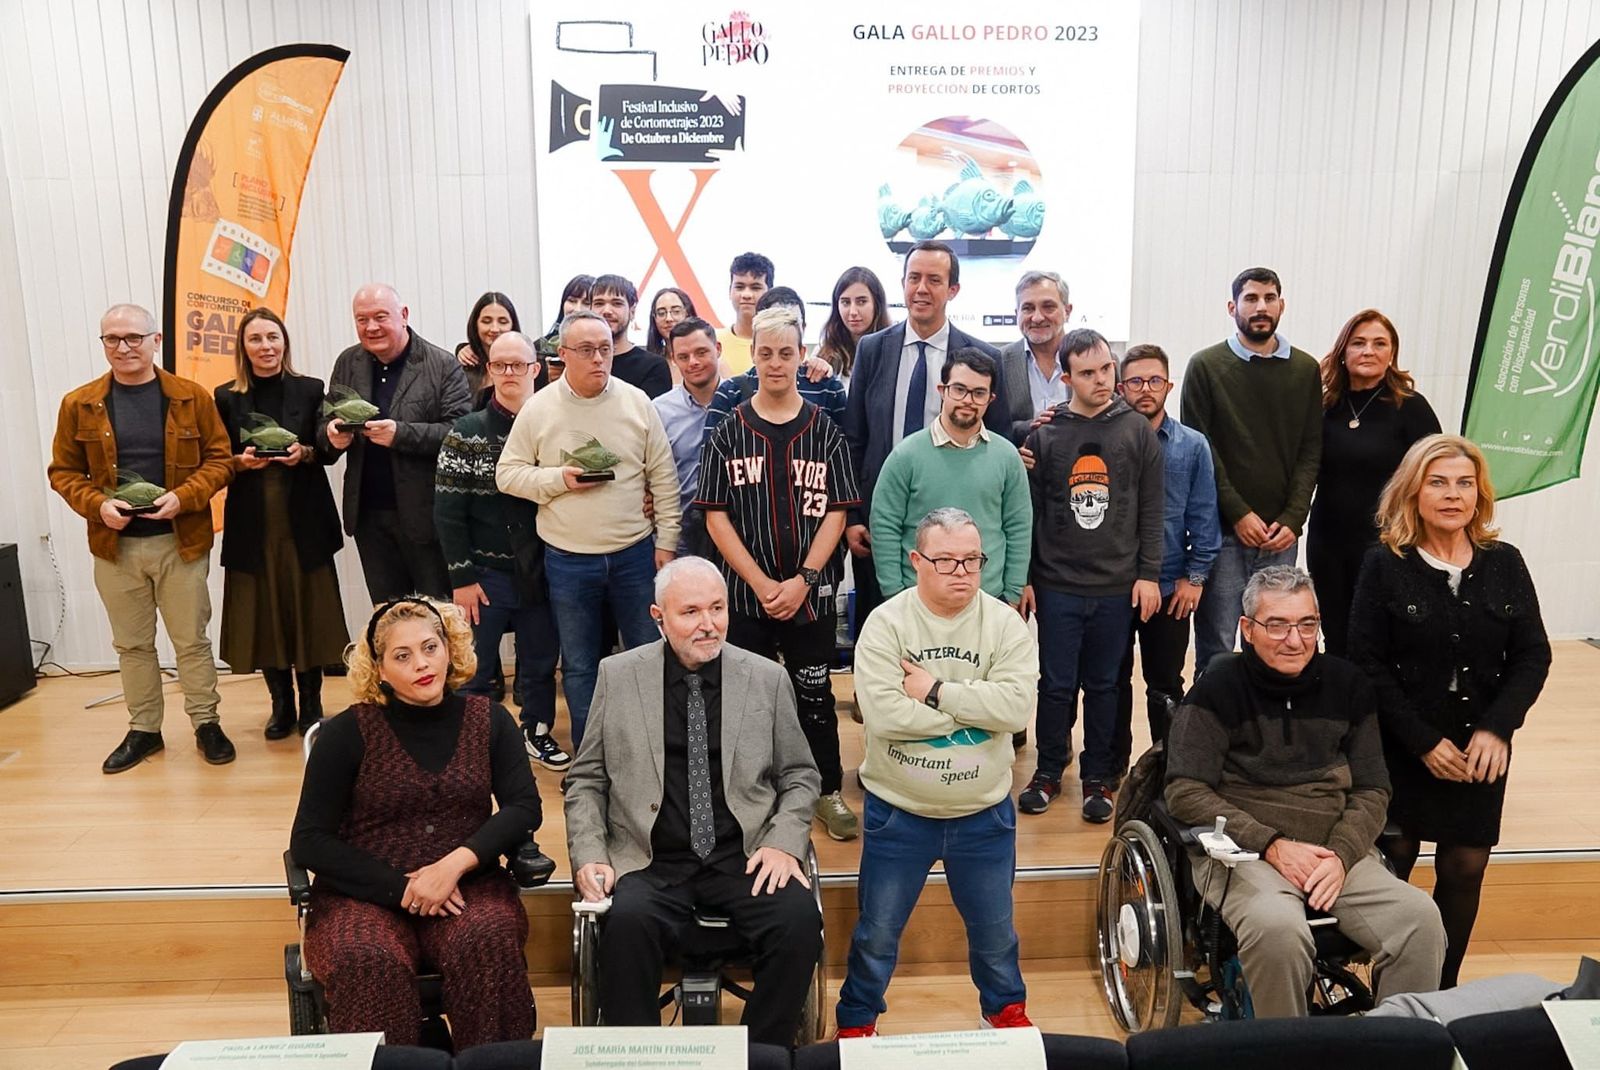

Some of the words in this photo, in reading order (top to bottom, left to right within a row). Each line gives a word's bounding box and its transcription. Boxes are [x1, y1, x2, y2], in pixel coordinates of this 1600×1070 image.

[853, 24, 905, 40] GALA
[911, 24, 976, 41] GALLO
[983, 25, 1048, 41] PEDRO
[1054, 26, 1099, 41] 2023
[702, 42, 769, 66] PEDRO
[890, 65, 947, 76] ENTREGA
[950, 65, 966, 76] DE
[969, 66, 1025, 76] PREMIOS
[1028, 66, 1036, 76] Y
[972, 84, 987, 94] DE
[991, 84, 1041, 95] CORTOS
[622, 100, 657, 113] Festival
[658, 100, 698, 113] Inclusivo
[620, 116, 633, 128] de
[633, 116, 699, 130] Cortometrajes
[699, 115, 724, 128] 2023
[621, 132, 634, 144] De
[634, 132, 671, 144] Octubre
[671, 135, 678, 144] a
[678, 132, 725, 144] Diciembre
[611, 169, 726, 330] X
[187, 292, 239, 305] CONCURSO
[187, 300, 249, 314] CORTOMETRA
[1510, 278, 1531, 324] Personas
[187, 310, 239, 335] GAL
[1507, 325, 1519, 338] de
[187, 331, 237, 356] PED
[1511, 308, 1537, 374] Discapacidad
[1493, 339, 1515, 393] Asociación
[1509, 375, 1520, 393] con
[792, 459, 827, 490] YOR
[803, 491, 828, 518] 23
[887, 743, 952, 770] Important
[940, 765, 980, 785] speed
[597, 1043, 626, 1055] MARÍA
[628, 1043, 662, 1055] MARTÍN
[665, 1043, 716, 1055] FERNÁNDEZ
